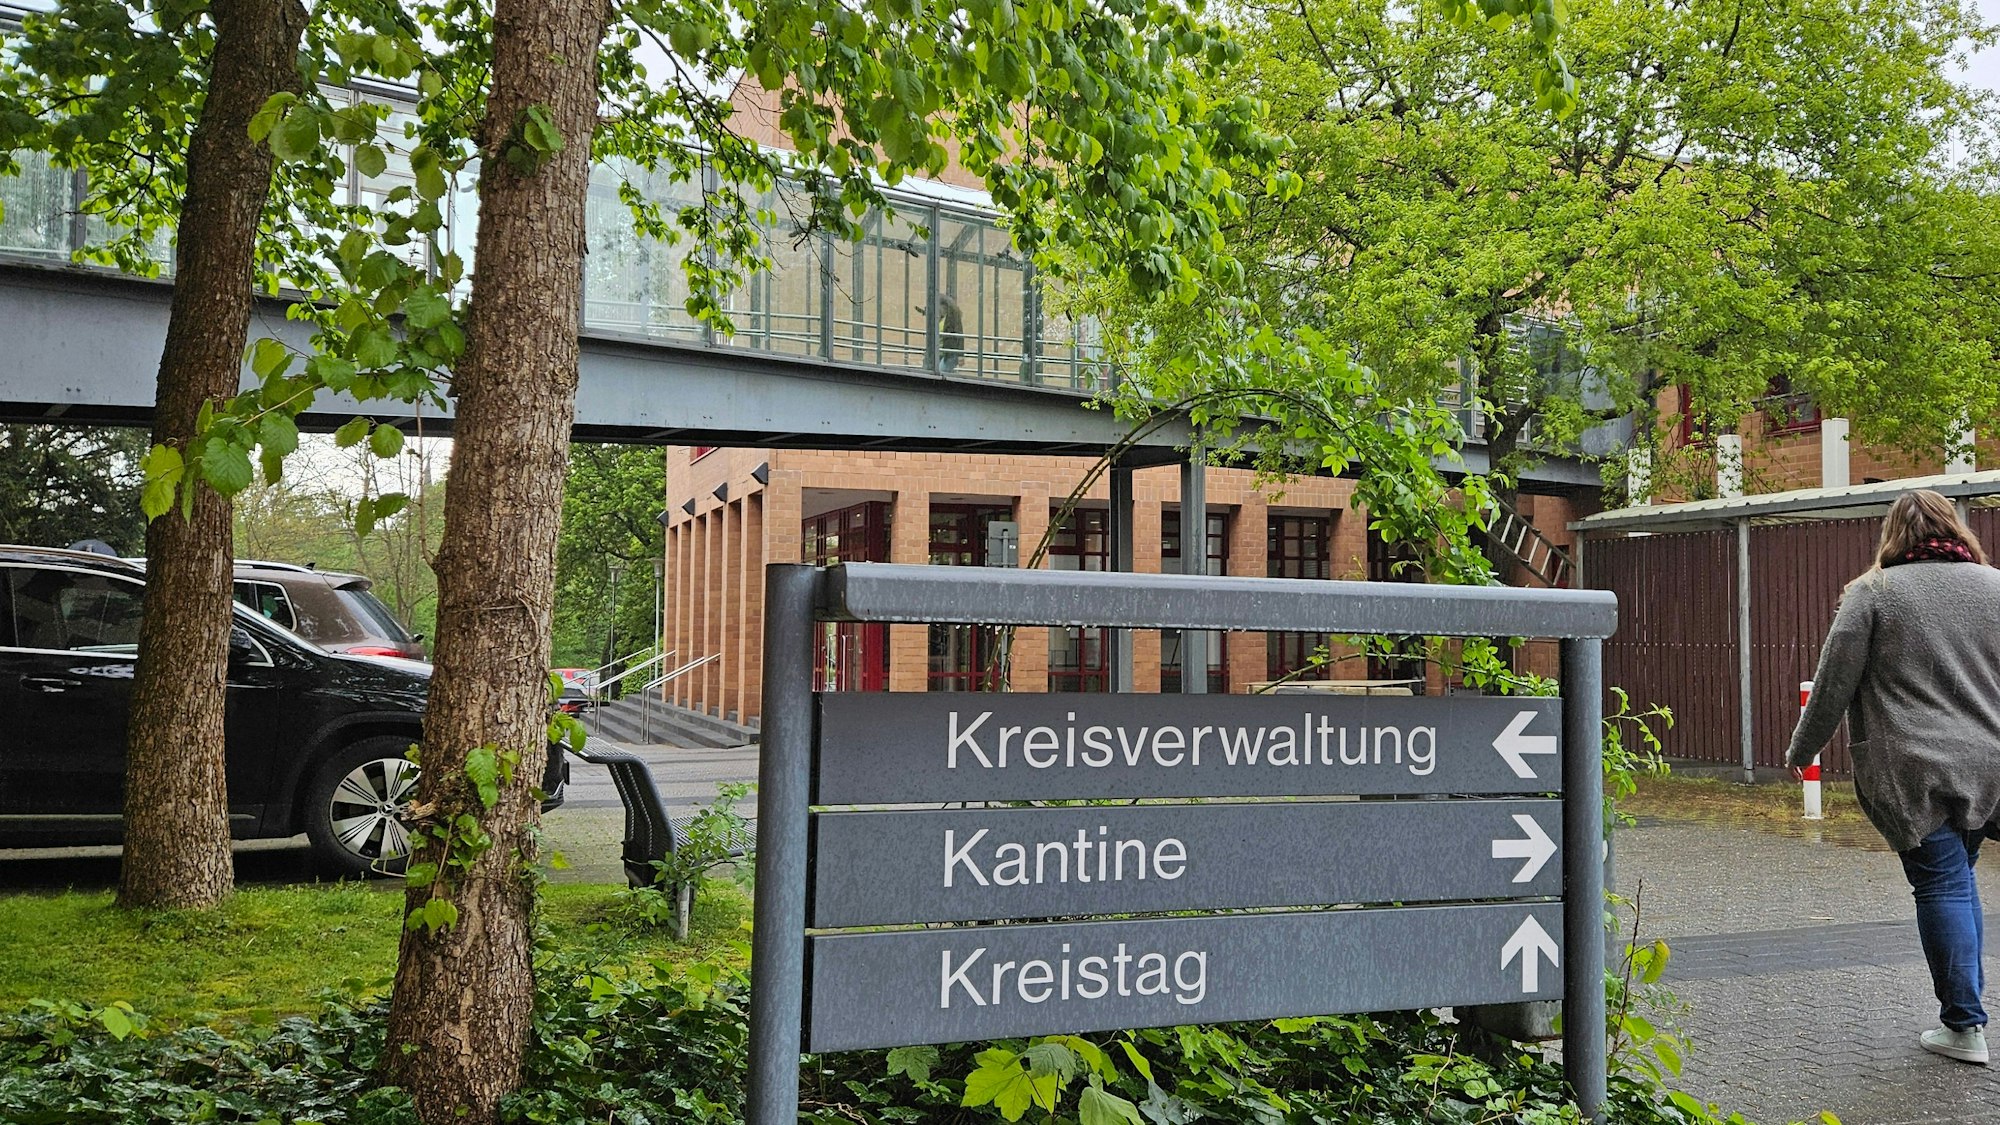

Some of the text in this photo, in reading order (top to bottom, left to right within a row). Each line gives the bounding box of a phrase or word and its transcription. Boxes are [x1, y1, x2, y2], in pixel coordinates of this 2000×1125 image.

[948, 712, 1435, 775] Kreisverwaltung
[944, 826, 1186, 887] Kantine
[941, 943, 1206, 1008] Kreistag
